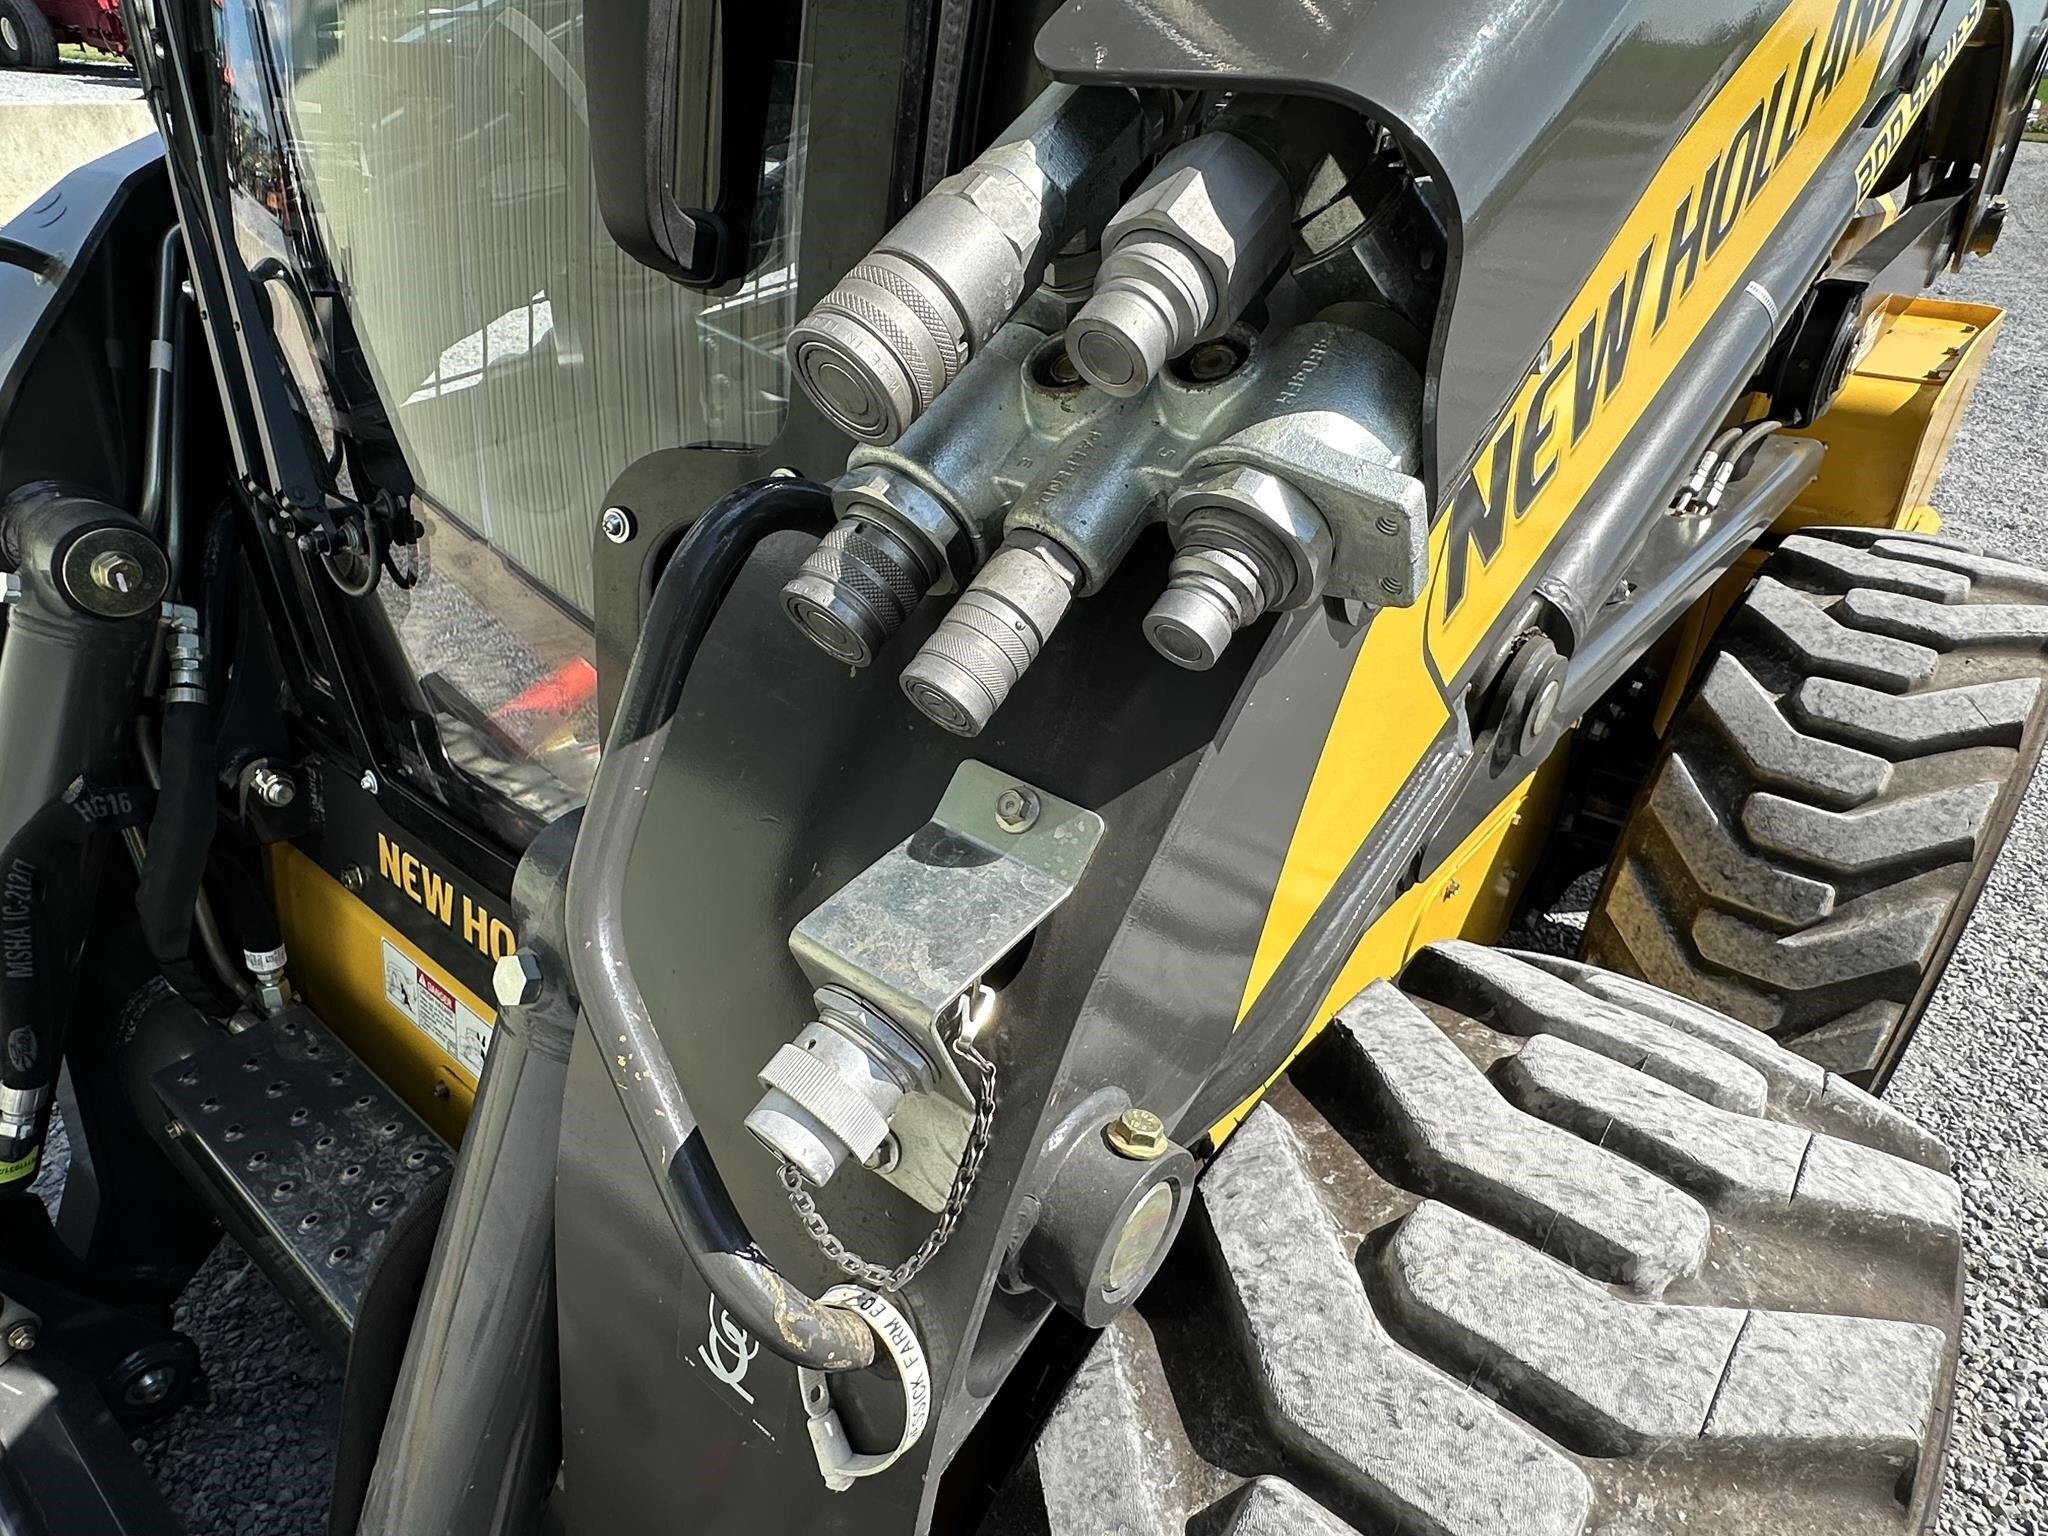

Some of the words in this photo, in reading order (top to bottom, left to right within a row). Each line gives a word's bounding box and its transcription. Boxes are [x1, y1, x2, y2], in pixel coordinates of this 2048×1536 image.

[1446, 234, 1658, 618] NEW
[73, 791, 133, 823] HG16
[378, 831, 454, 927] NEW
[4, 926, 34, 978] MSHA
[884, 1316, 919, 1369] FARM
